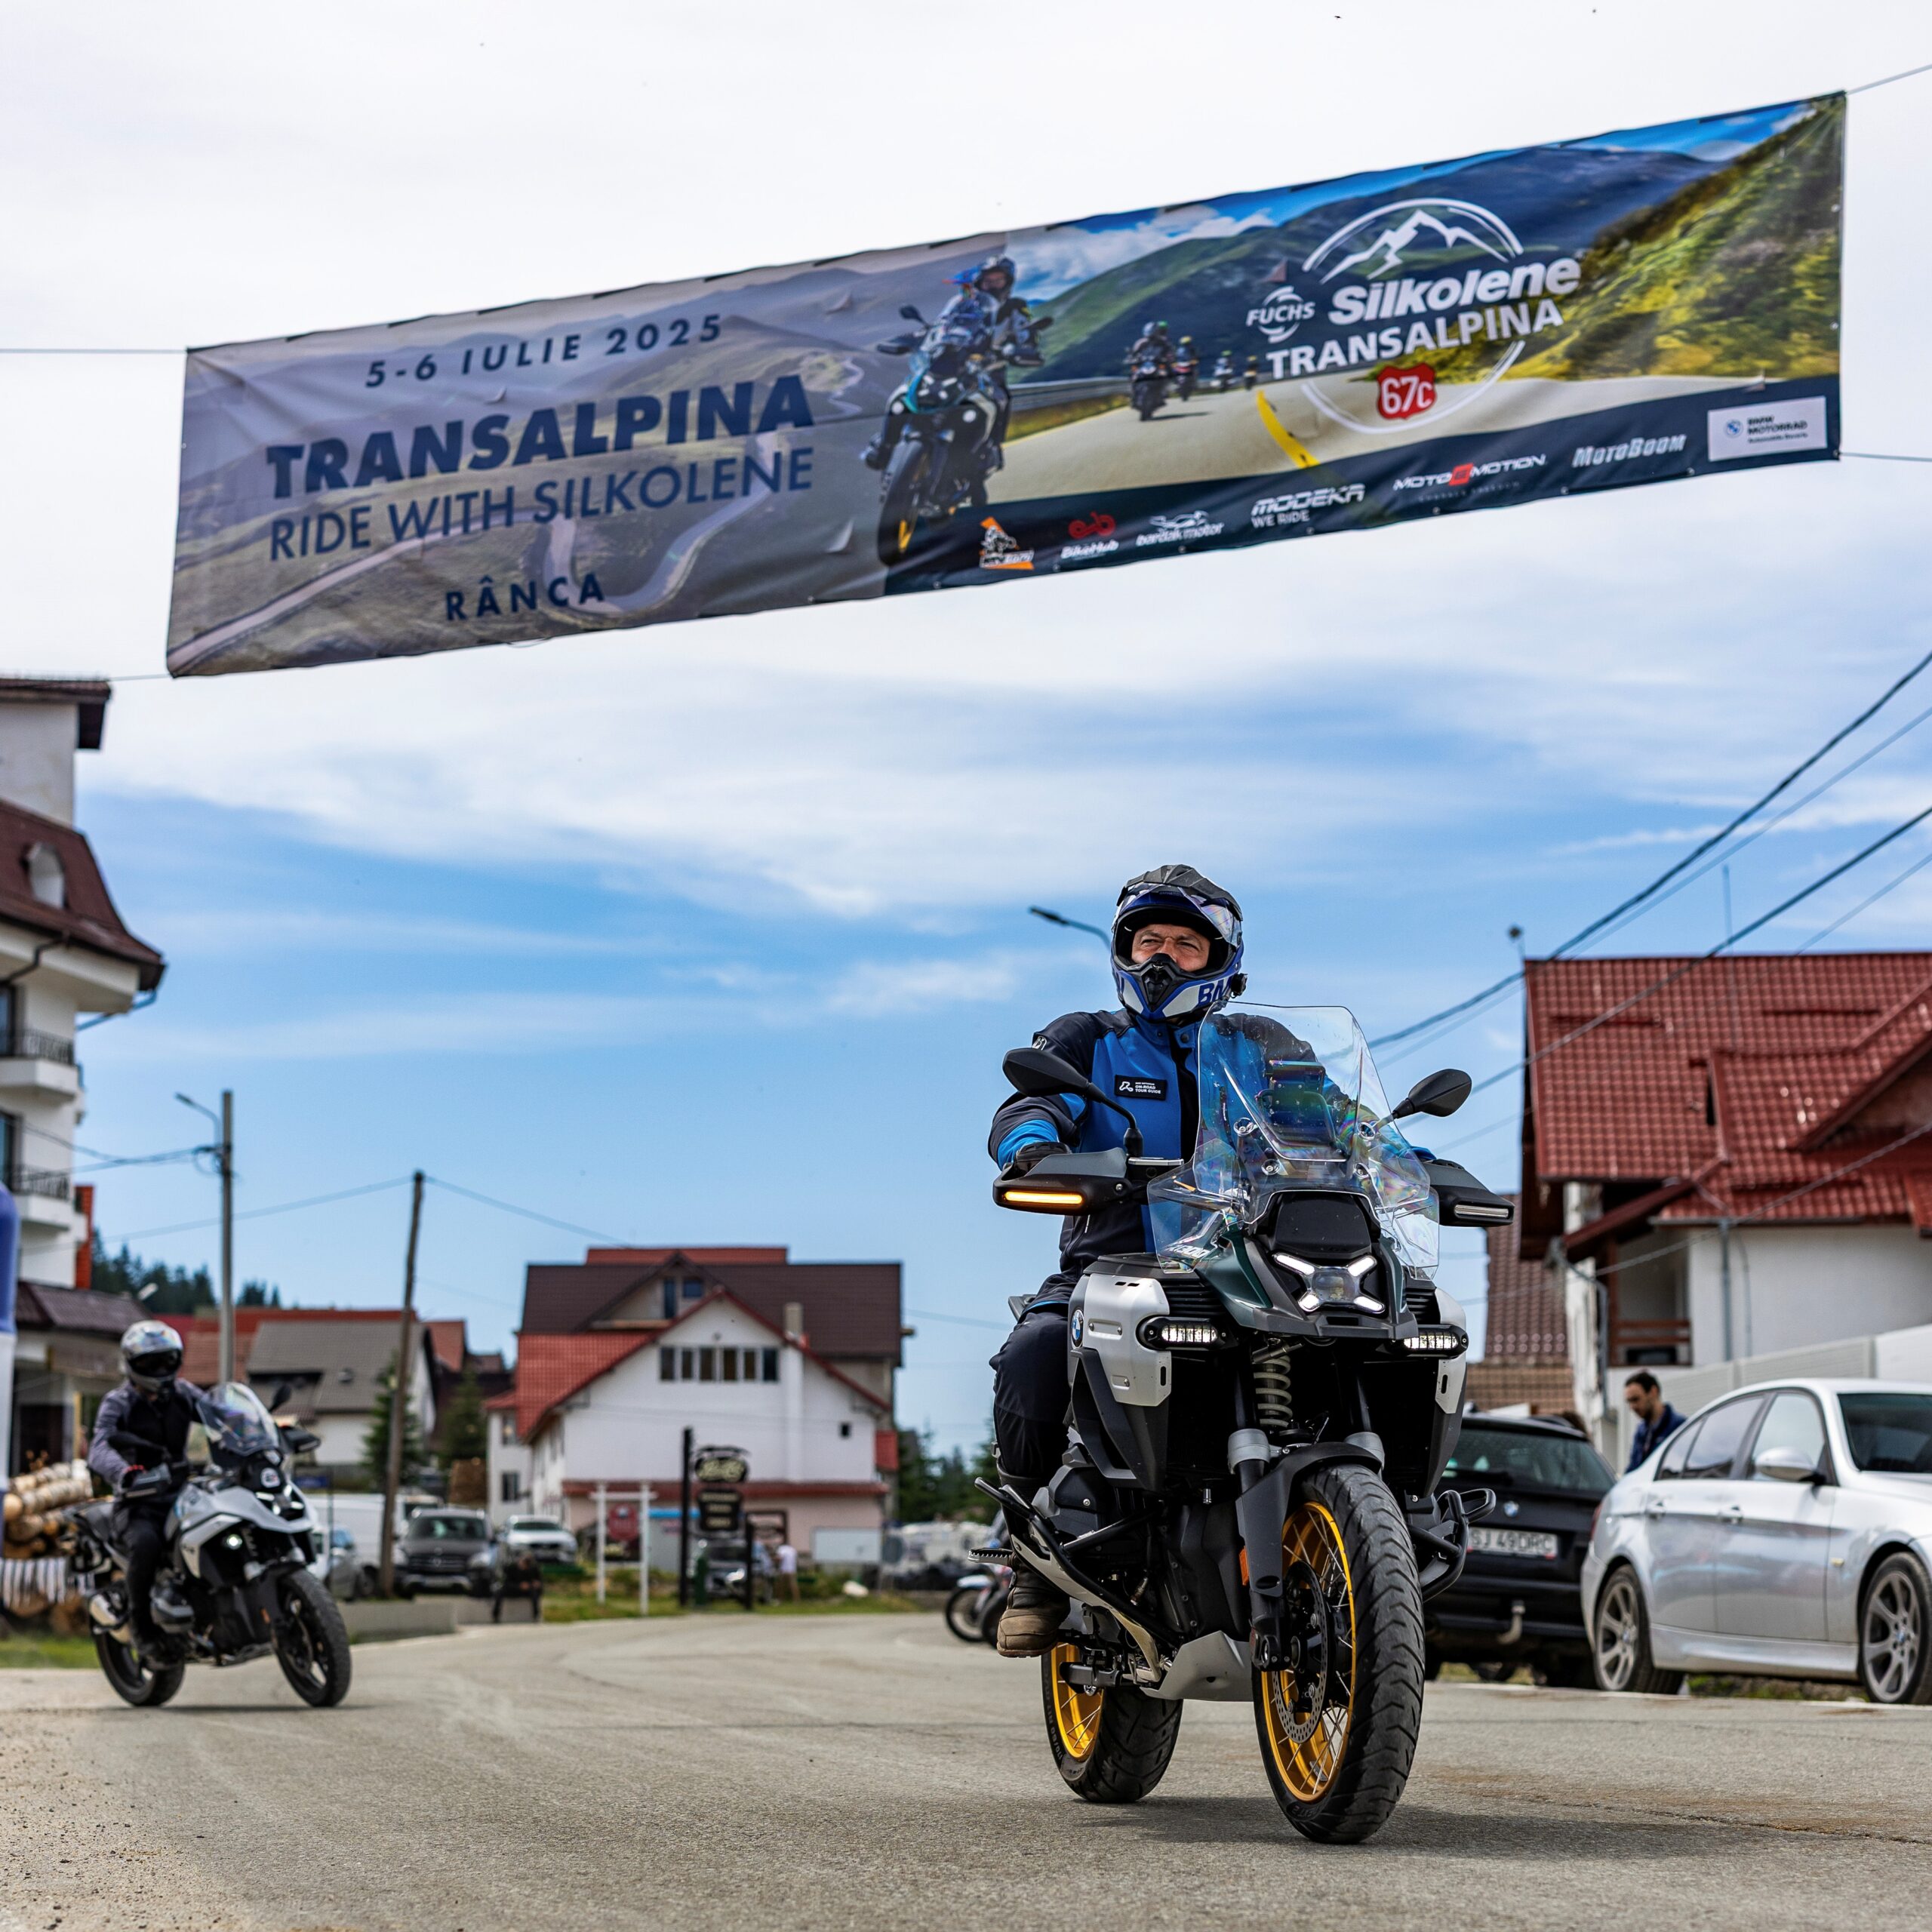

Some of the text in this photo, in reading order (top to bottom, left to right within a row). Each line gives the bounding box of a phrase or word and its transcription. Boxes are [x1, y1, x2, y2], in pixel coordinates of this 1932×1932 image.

[1246, 303, 1315, 327] FUCHS
[1328, 257, 1580, 325] Silkolene
[366, 315, 721, 387] 5-6 IULIE 2025
[1266, 300, 1563, 379] TRANSALPINA
[266, 375, 814, 499] TRANSALPINA
[1748, 420, 1807, 435] MOTORRAD
[270, 448, 814, 561] RIDE WITH SILKOLENE
[1251, 483, 1366, 516] MODEKA
[1251, 509, 1309, 528] WE RIDE
[445, 572, 604, 621] RÂNCA
[1198, 976, 1232, 1005] BM
